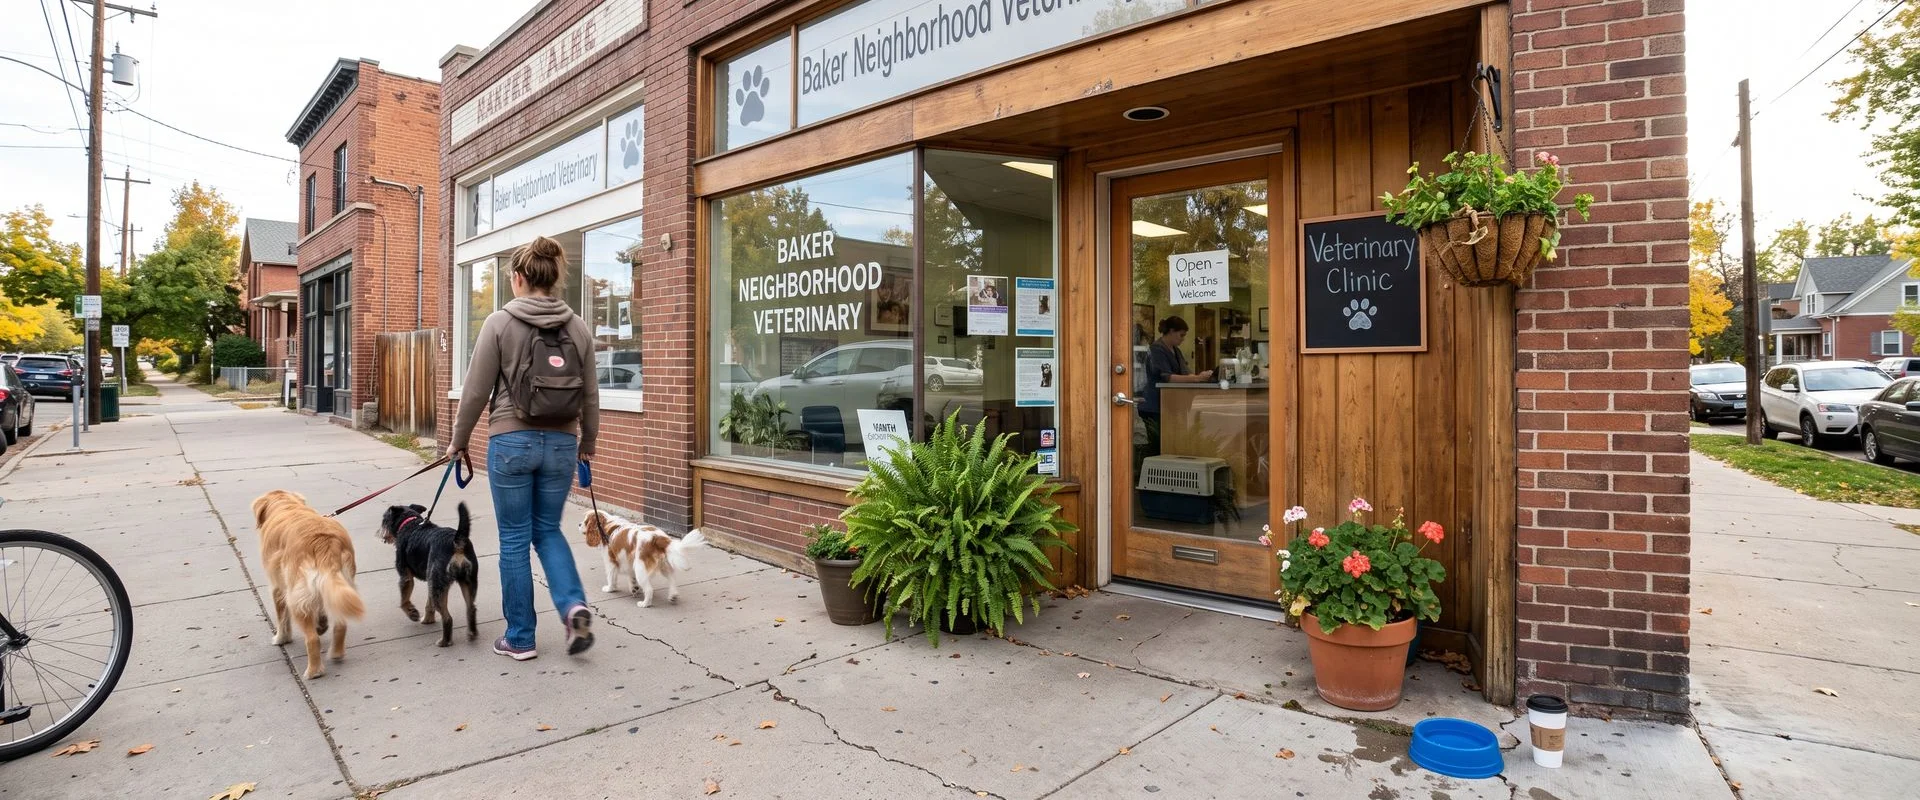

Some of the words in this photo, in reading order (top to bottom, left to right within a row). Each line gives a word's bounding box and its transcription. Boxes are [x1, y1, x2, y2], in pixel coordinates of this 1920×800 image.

[802, 48, 848, 96] Baker
[853, 0, 991, 78] Neighborhood
[495, 186, 511, 213] Baker
[512, 163, 556, 208] Neighborhood
[557, 152, 598, 187] Veterinary
[777, 230, 834, 264] BAKER
[1309, 232, 1415, 271] Veterinary
[739, 261, 883, 302] NEIGHBORHOOD
[1175, 276, 1218, 288] Walk-Ins
[1176, 257, 1212, 277] Open
[1326, 267, 1393, 294] Clinic
[1179, 289, 1217, 299] Welcome
[753, 301, 863, 335] VETERINARY
